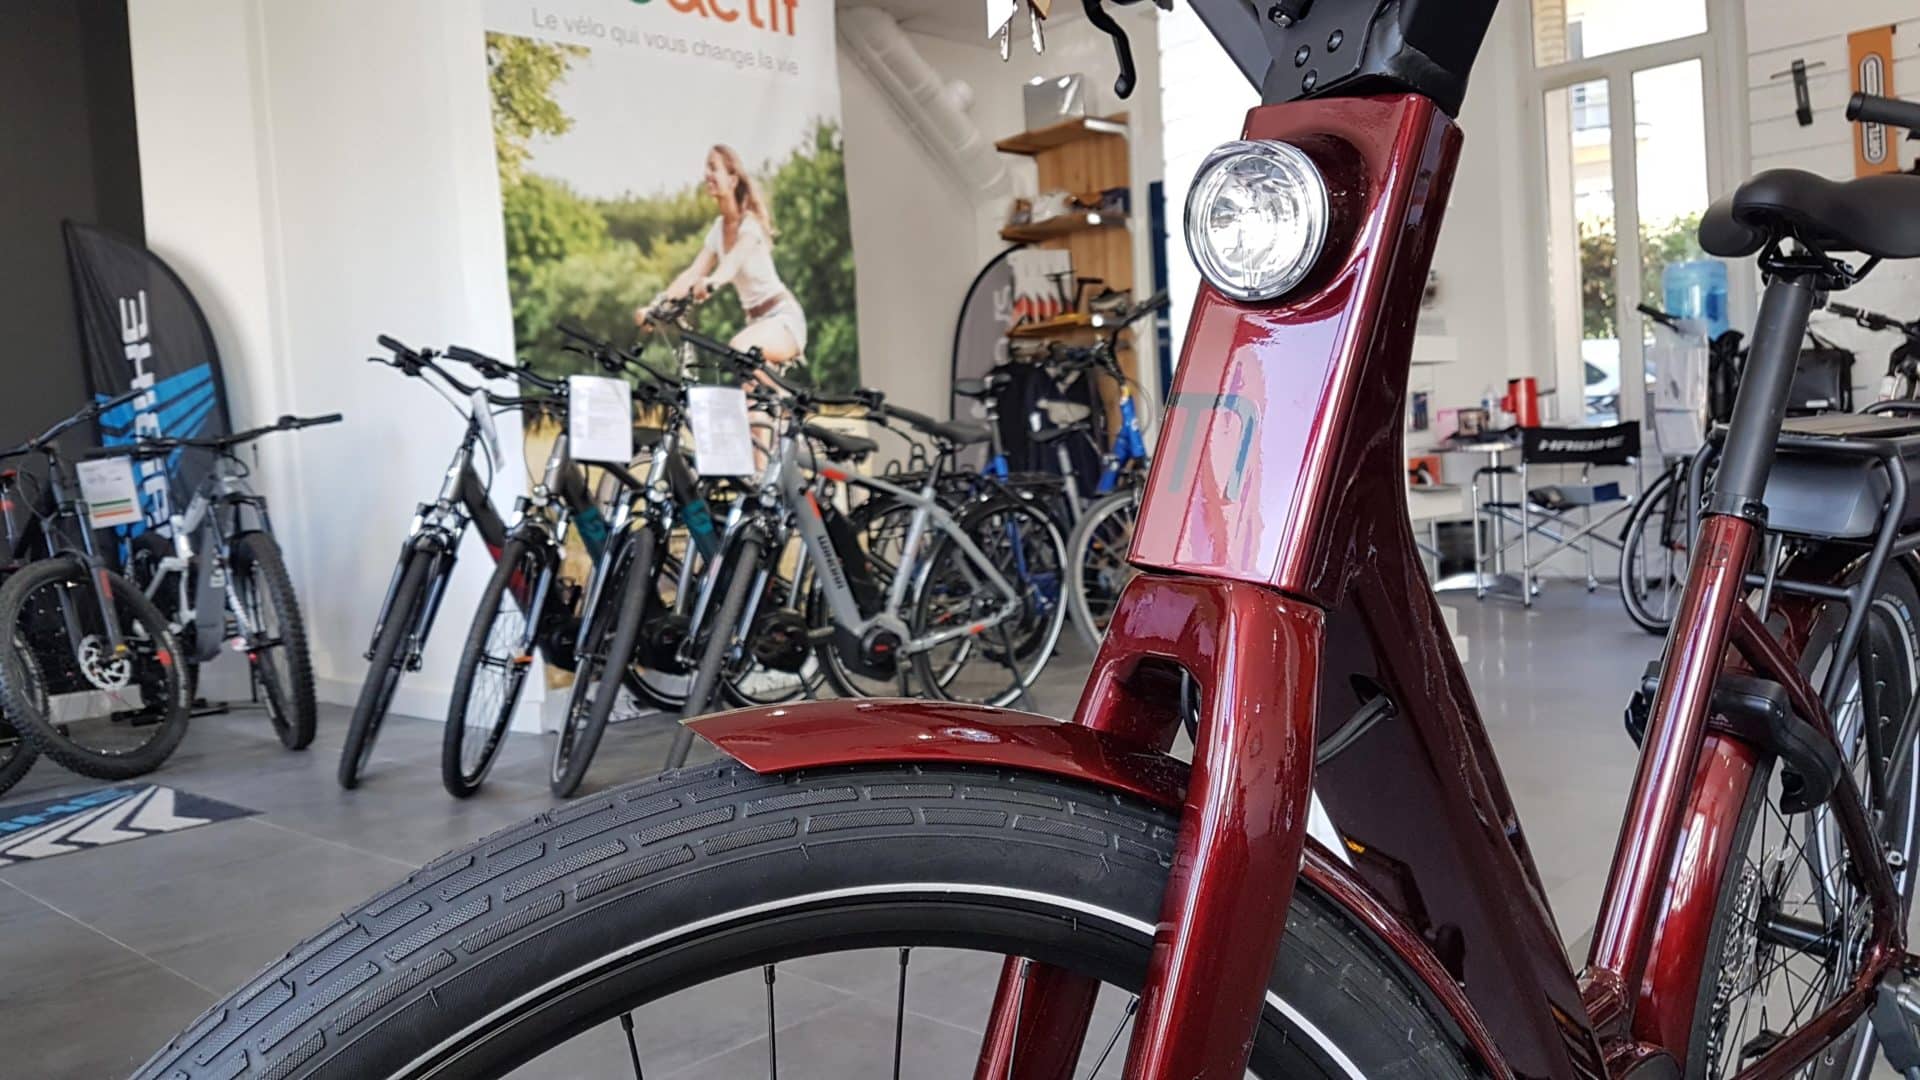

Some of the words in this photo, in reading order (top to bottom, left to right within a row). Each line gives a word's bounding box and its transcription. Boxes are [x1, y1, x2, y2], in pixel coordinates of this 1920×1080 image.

[531, 7, 558, 30] Le
[563, 15, 607, 38] vélo
[610, 25, 640, 48] qui
[643, 31, 688, 54] vous
[692, 39, 755, 69] change
[758, 49, 774, 70] la
[777, 57, 799, 76] vie
